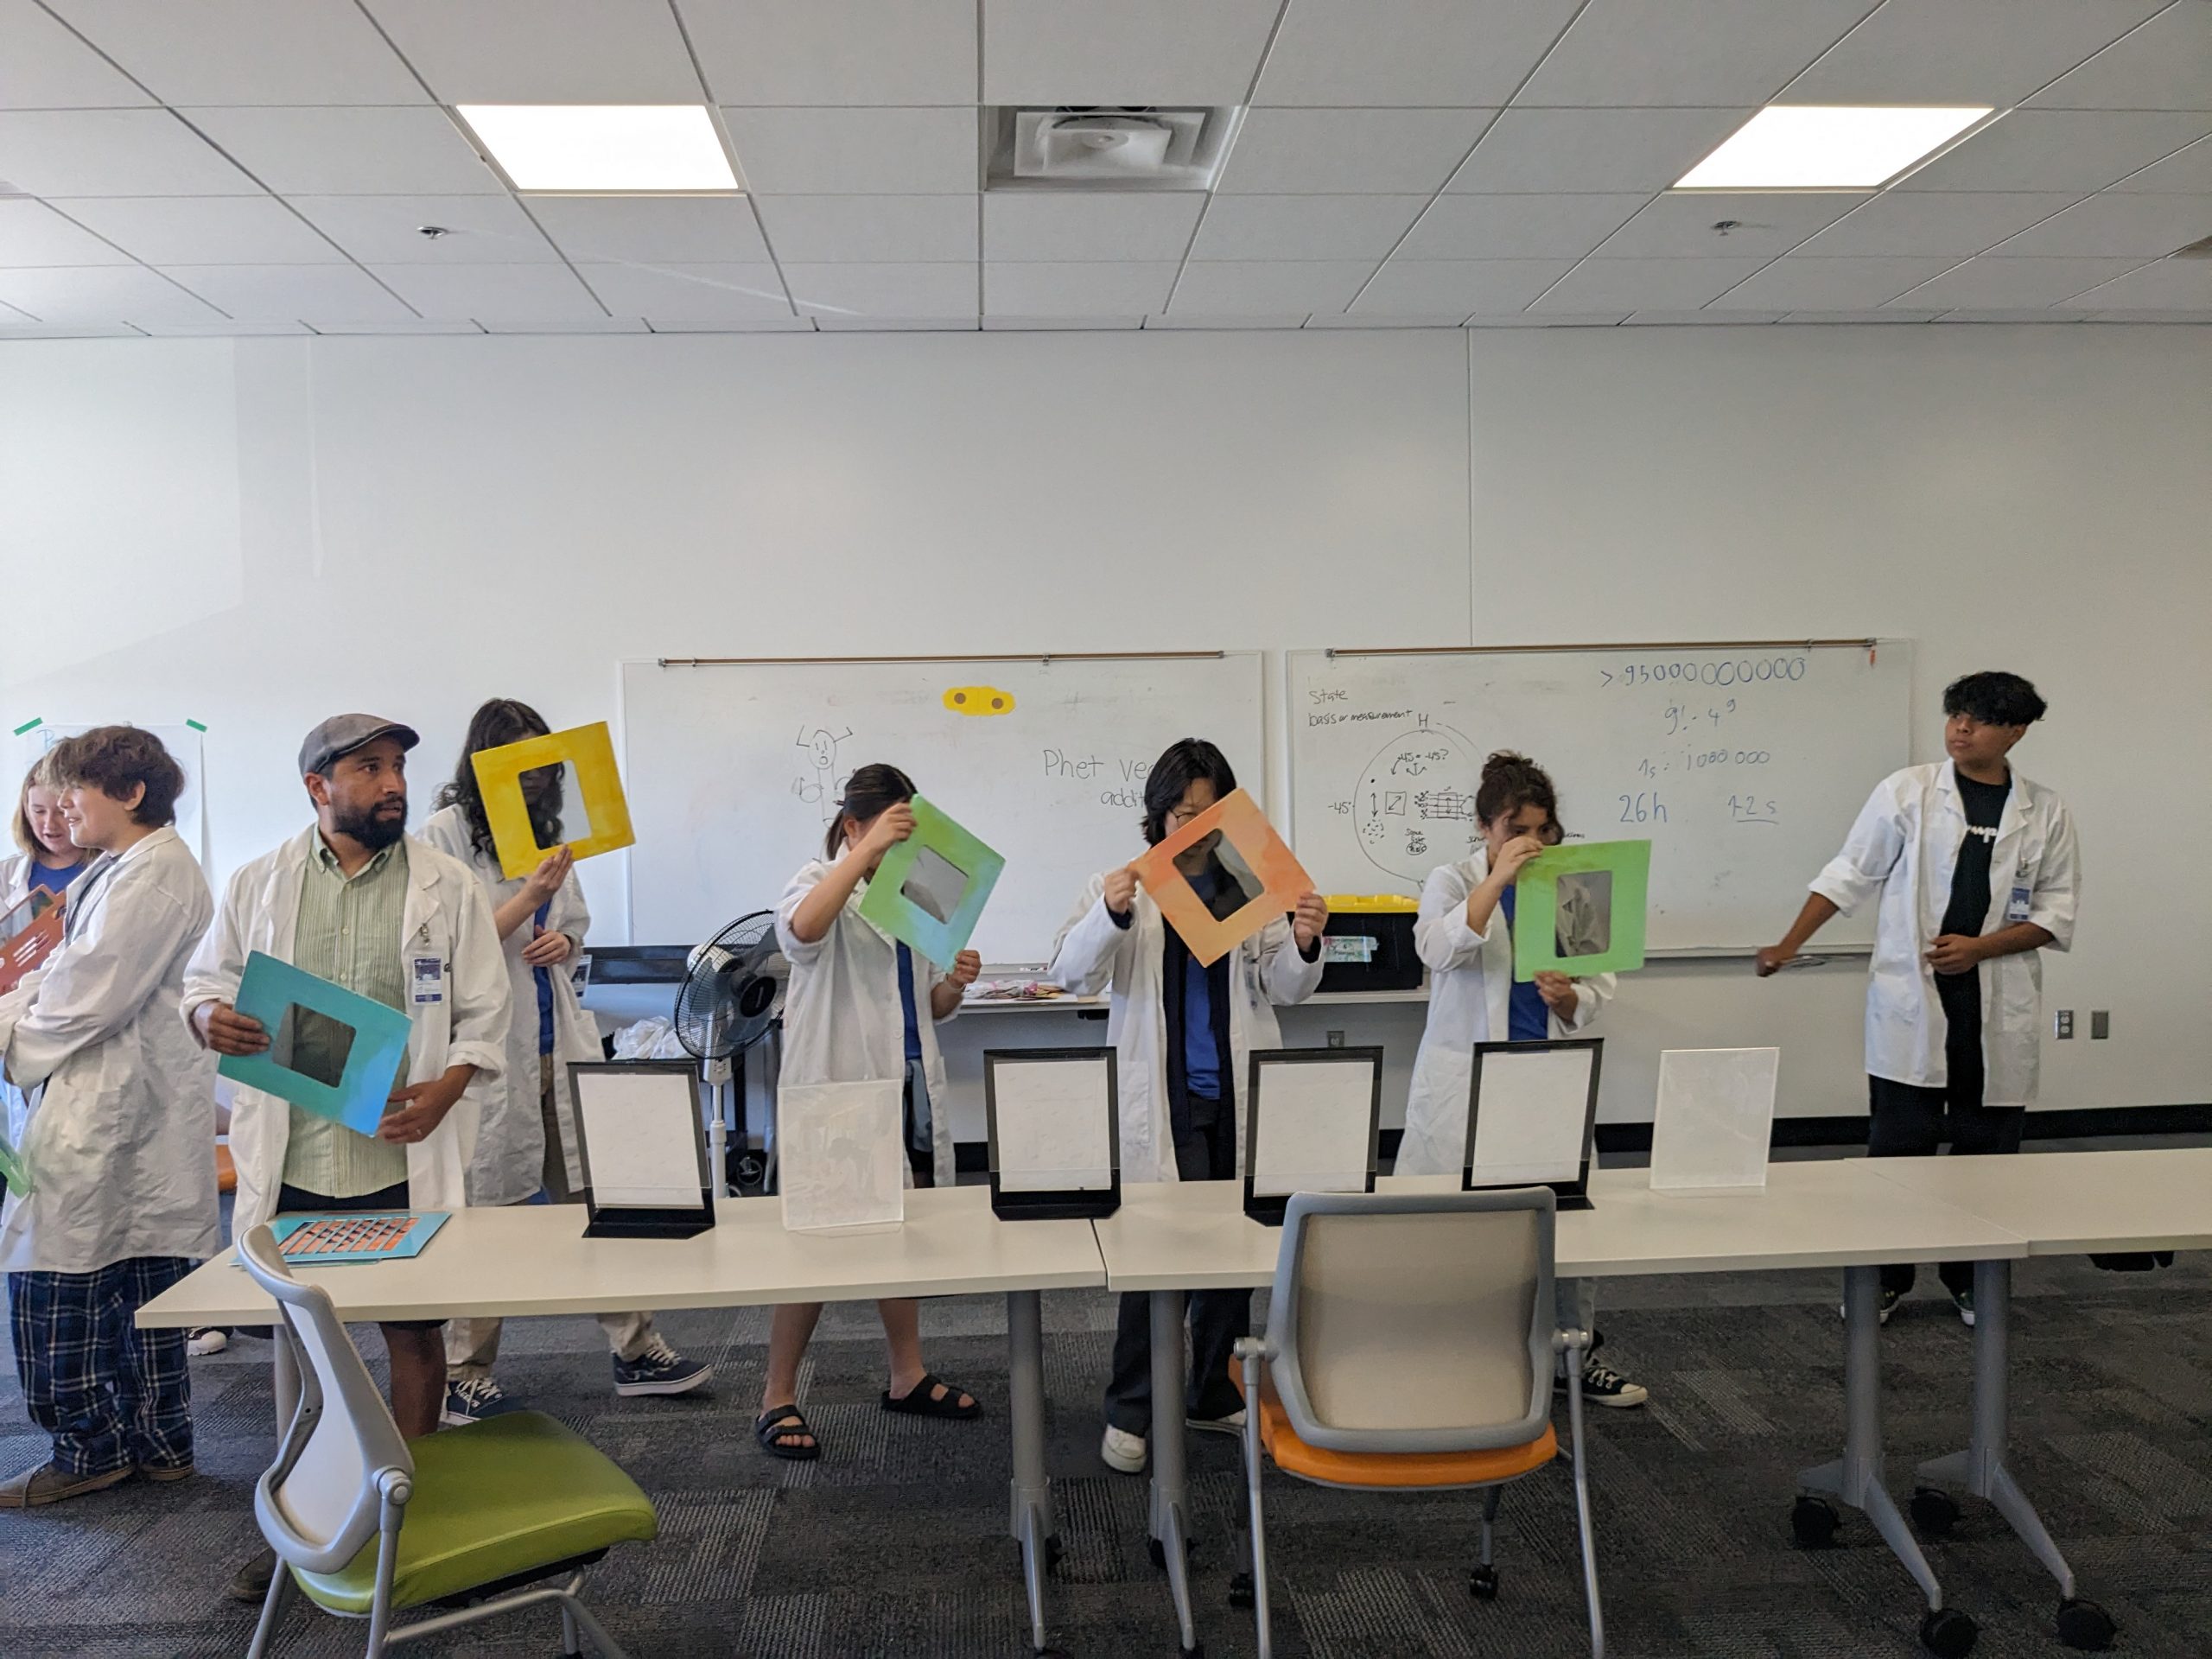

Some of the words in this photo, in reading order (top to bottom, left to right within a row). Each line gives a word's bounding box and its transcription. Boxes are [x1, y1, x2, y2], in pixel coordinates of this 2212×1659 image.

[1308, 689, 1349, 705] State
[1308, 711, 1337, 727] basis
[1417, 712, 1429, 728] H
[1043, 748, 1104, 779] Phet
